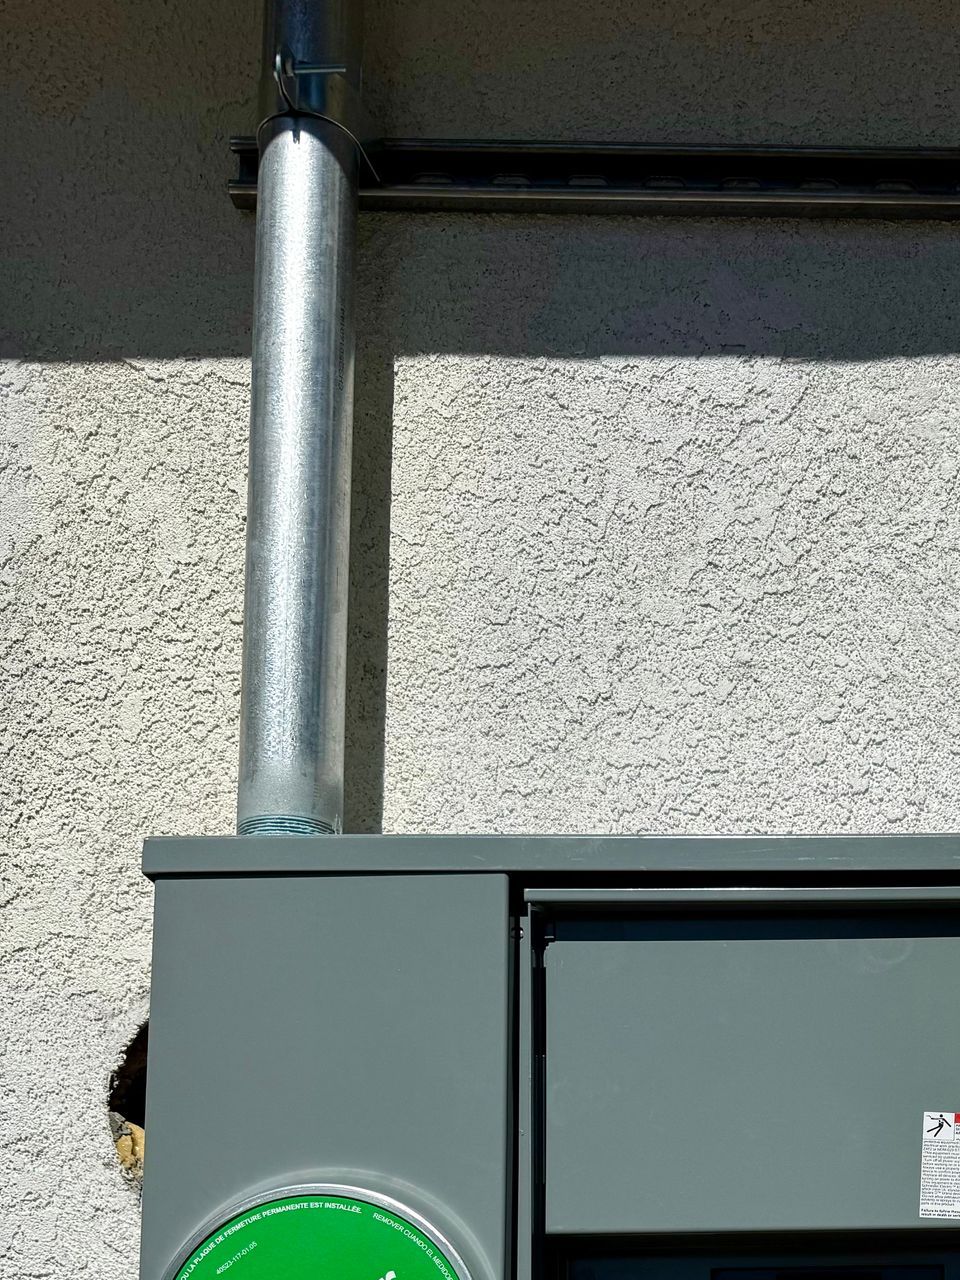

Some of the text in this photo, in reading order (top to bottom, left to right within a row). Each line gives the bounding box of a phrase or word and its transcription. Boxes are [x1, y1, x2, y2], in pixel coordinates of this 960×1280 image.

[186, 1263, 196, 1273] LA
[193, 1241, 216, 1265] PLAQUE
[214, 1234, 224, 1244] DE
[223, 1213, 262, 1237] FERMETURE
[261, 1202, 308, 1217] PERMANENTE
[372, 1212, 405, 1232] REMOVER
[403, 1229, 428, 1250] CUANDO
[425, 1248, 433, 1258] EL
